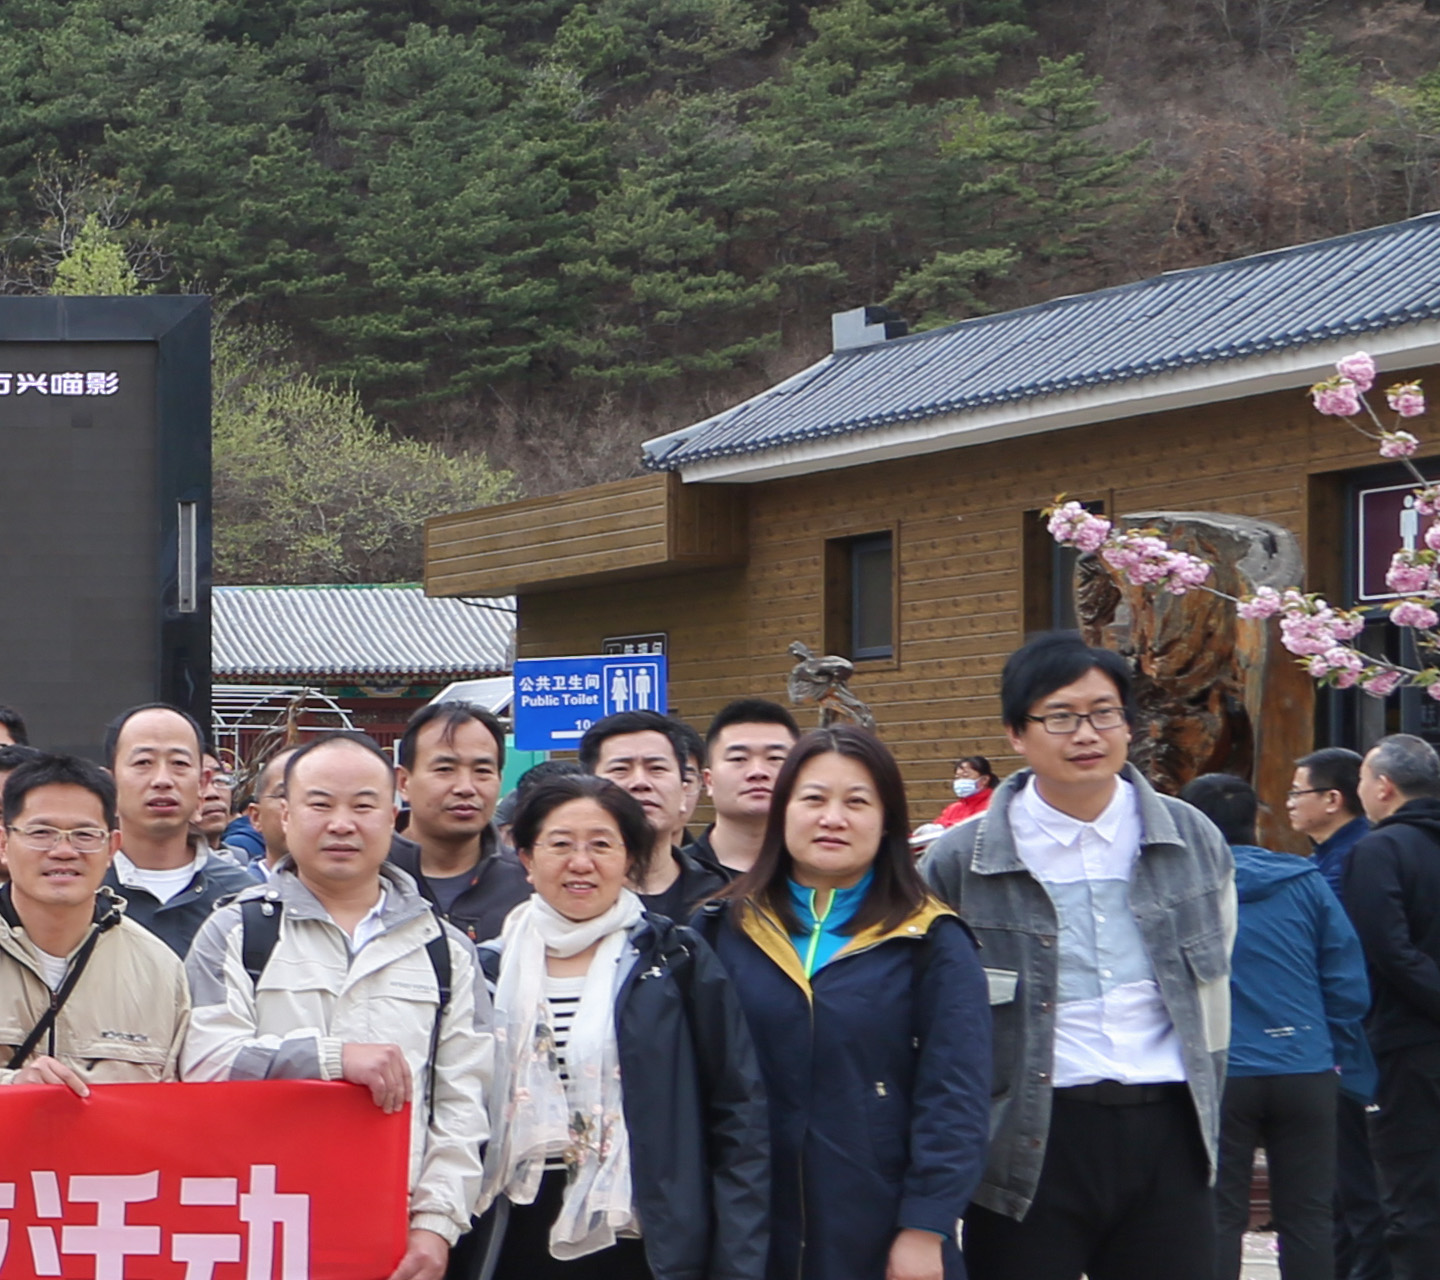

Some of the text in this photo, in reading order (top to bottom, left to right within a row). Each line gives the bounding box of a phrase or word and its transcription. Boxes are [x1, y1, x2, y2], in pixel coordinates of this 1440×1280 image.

[519, 674, 600, 691] 公共卫生间
[521, 694, 599, 707] Public Toilet
